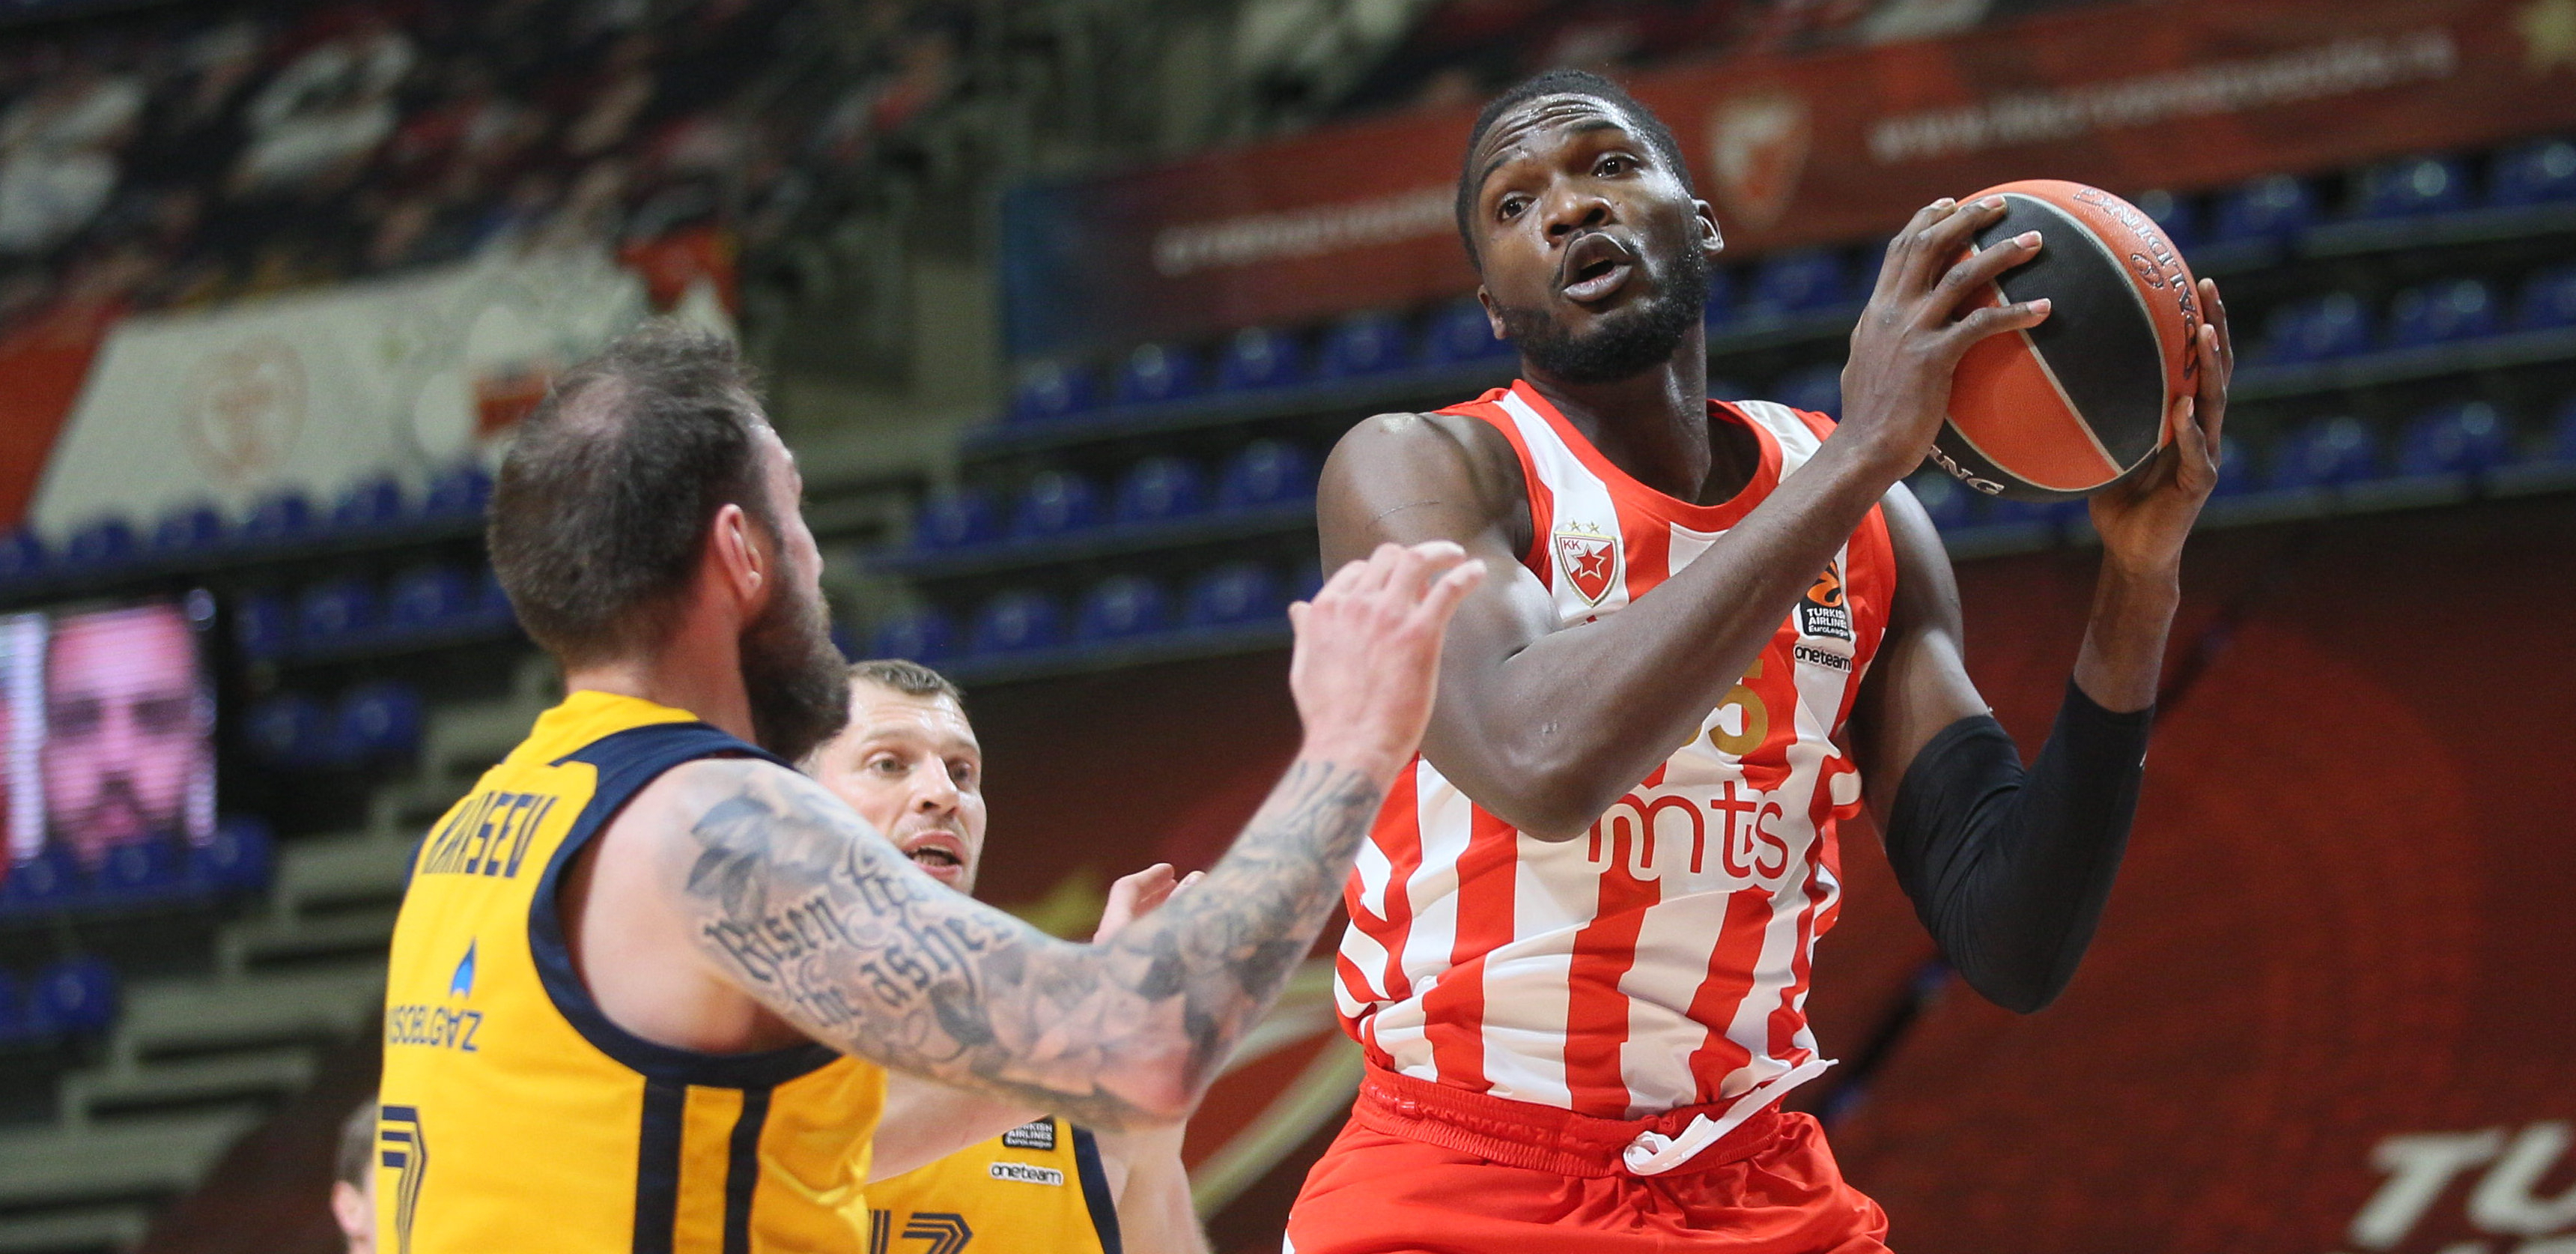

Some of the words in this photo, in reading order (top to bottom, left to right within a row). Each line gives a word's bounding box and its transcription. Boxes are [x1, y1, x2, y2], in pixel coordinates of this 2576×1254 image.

[1563, 539, 1581, 551] KK
[1806, 608, 1846, 620] TURKIS
[1794, 646, 1852, 671] oneteam
[1587, 781, 1789, 879] mts
[991, 1164, 1062, 1184] oneteam
